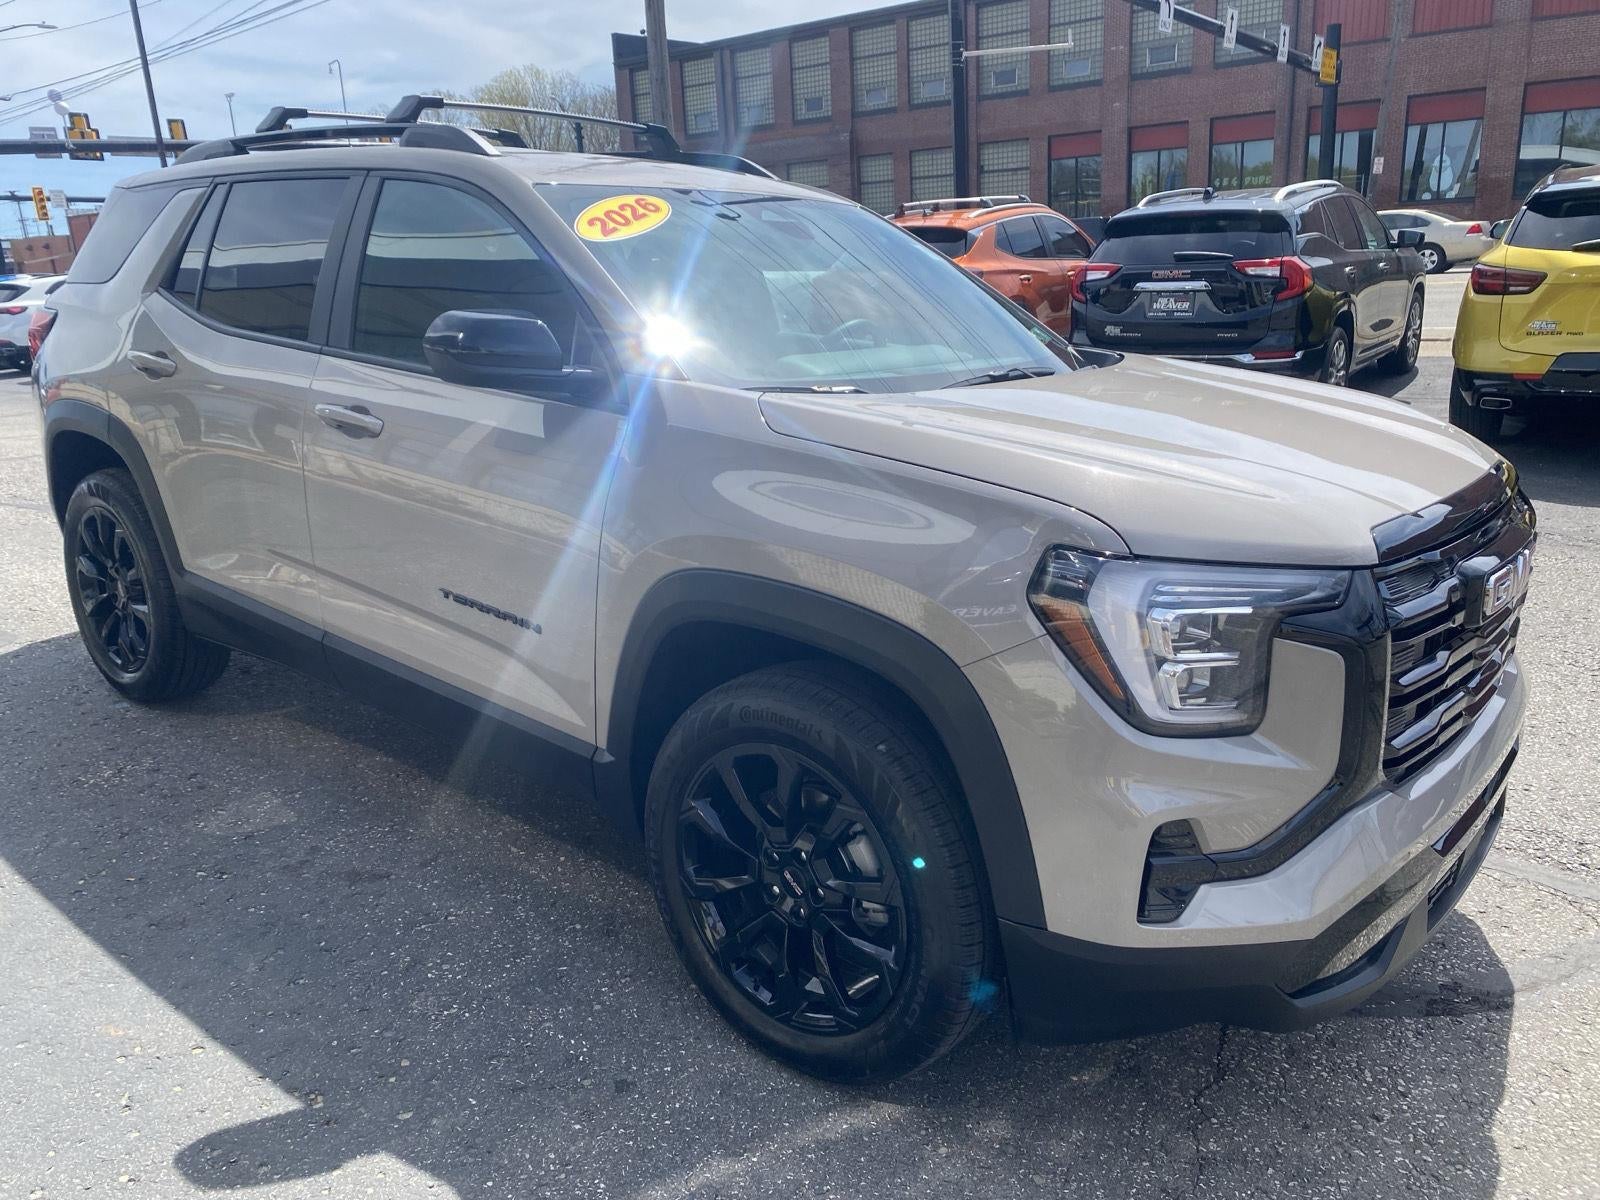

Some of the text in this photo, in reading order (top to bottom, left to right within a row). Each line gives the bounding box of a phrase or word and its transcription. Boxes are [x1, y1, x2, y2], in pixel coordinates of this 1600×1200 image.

[587, 197, 661, 238] 2026
[1152, 270, 1191, 278] GMC
[1153, 300, 1190, 310] WEAVER
[438, 588, 542, 635] TERRAIN
[741, 705, 814, 737] Continental
